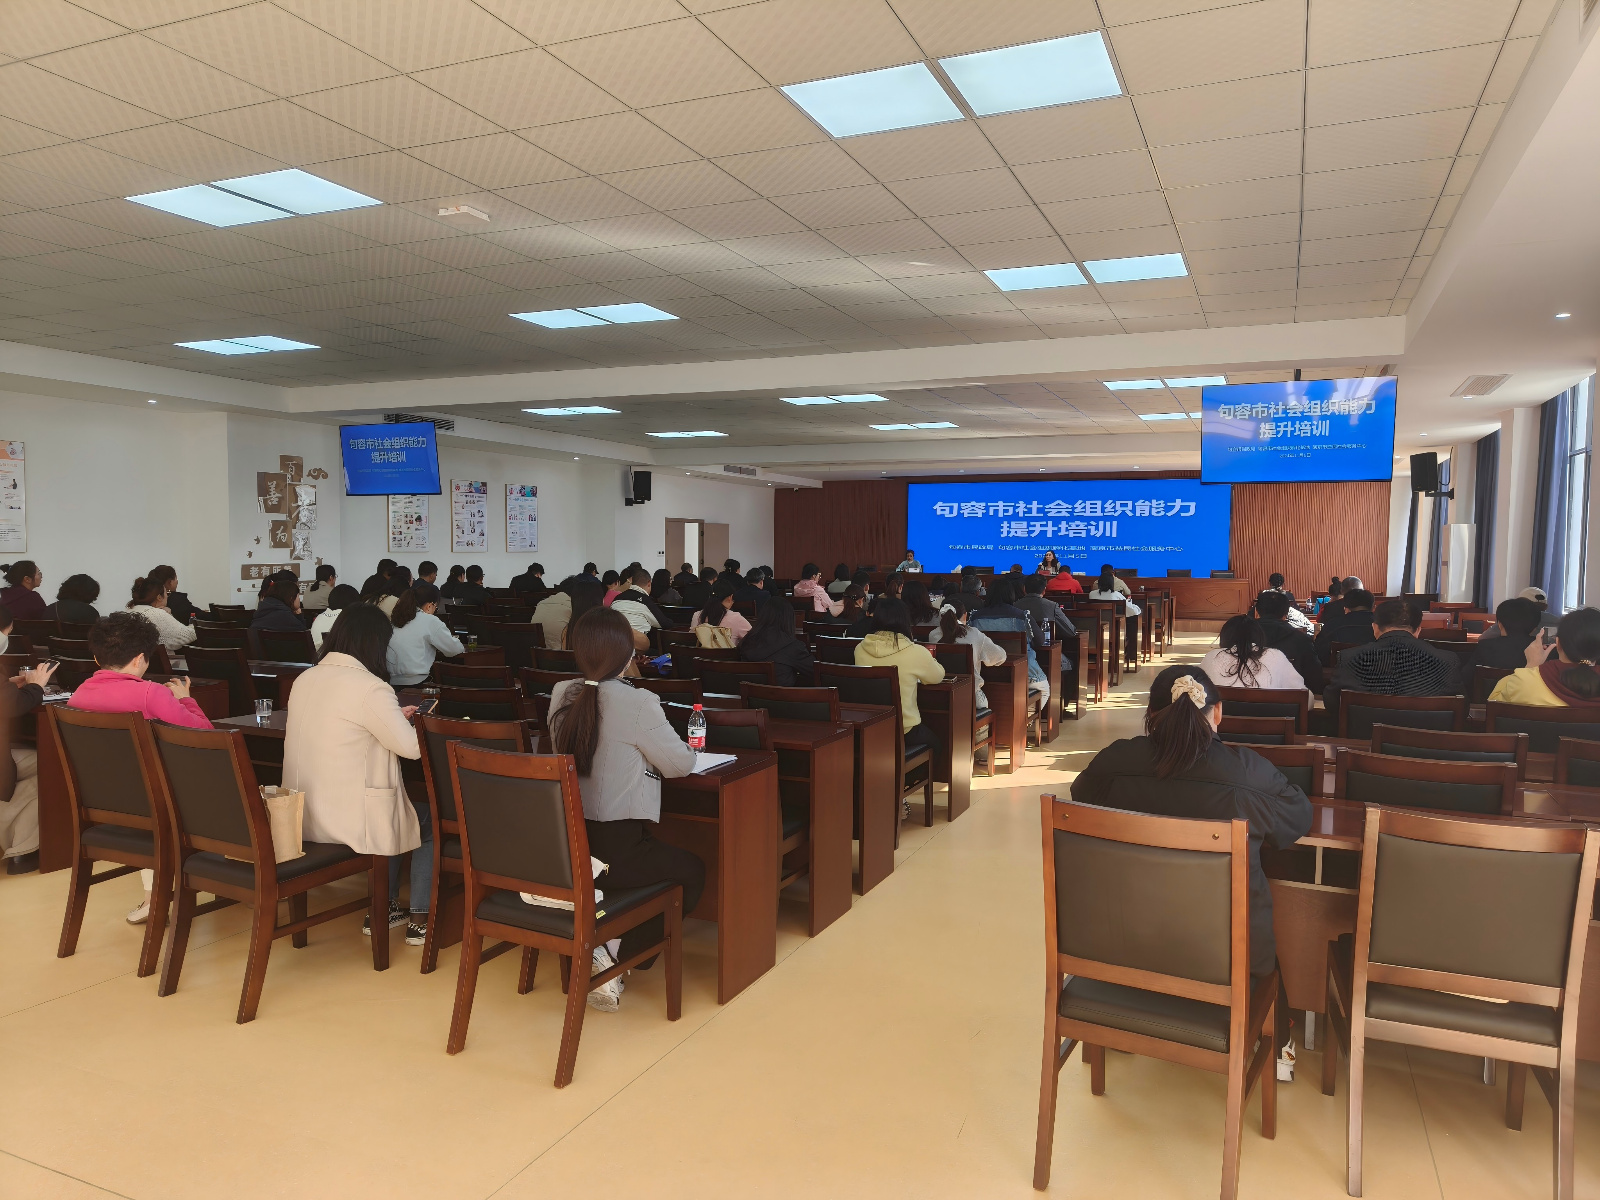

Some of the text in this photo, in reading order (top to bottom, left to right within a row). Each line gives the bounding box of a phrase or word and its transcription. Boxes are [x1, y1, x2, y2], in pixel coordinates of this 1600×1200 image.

[1218, 398, 1376, 420] 句容市社会组织能力
[1259, 419, 1330, 439] 提升培训
[349, 435, 427, 451] 句容市社会组织能力
[370, 451, 407, 464] 提升培训
[932, 498, 1197, 518] 句容市社会组织能力
[1000, 520, 1118, 539] 提升培训
